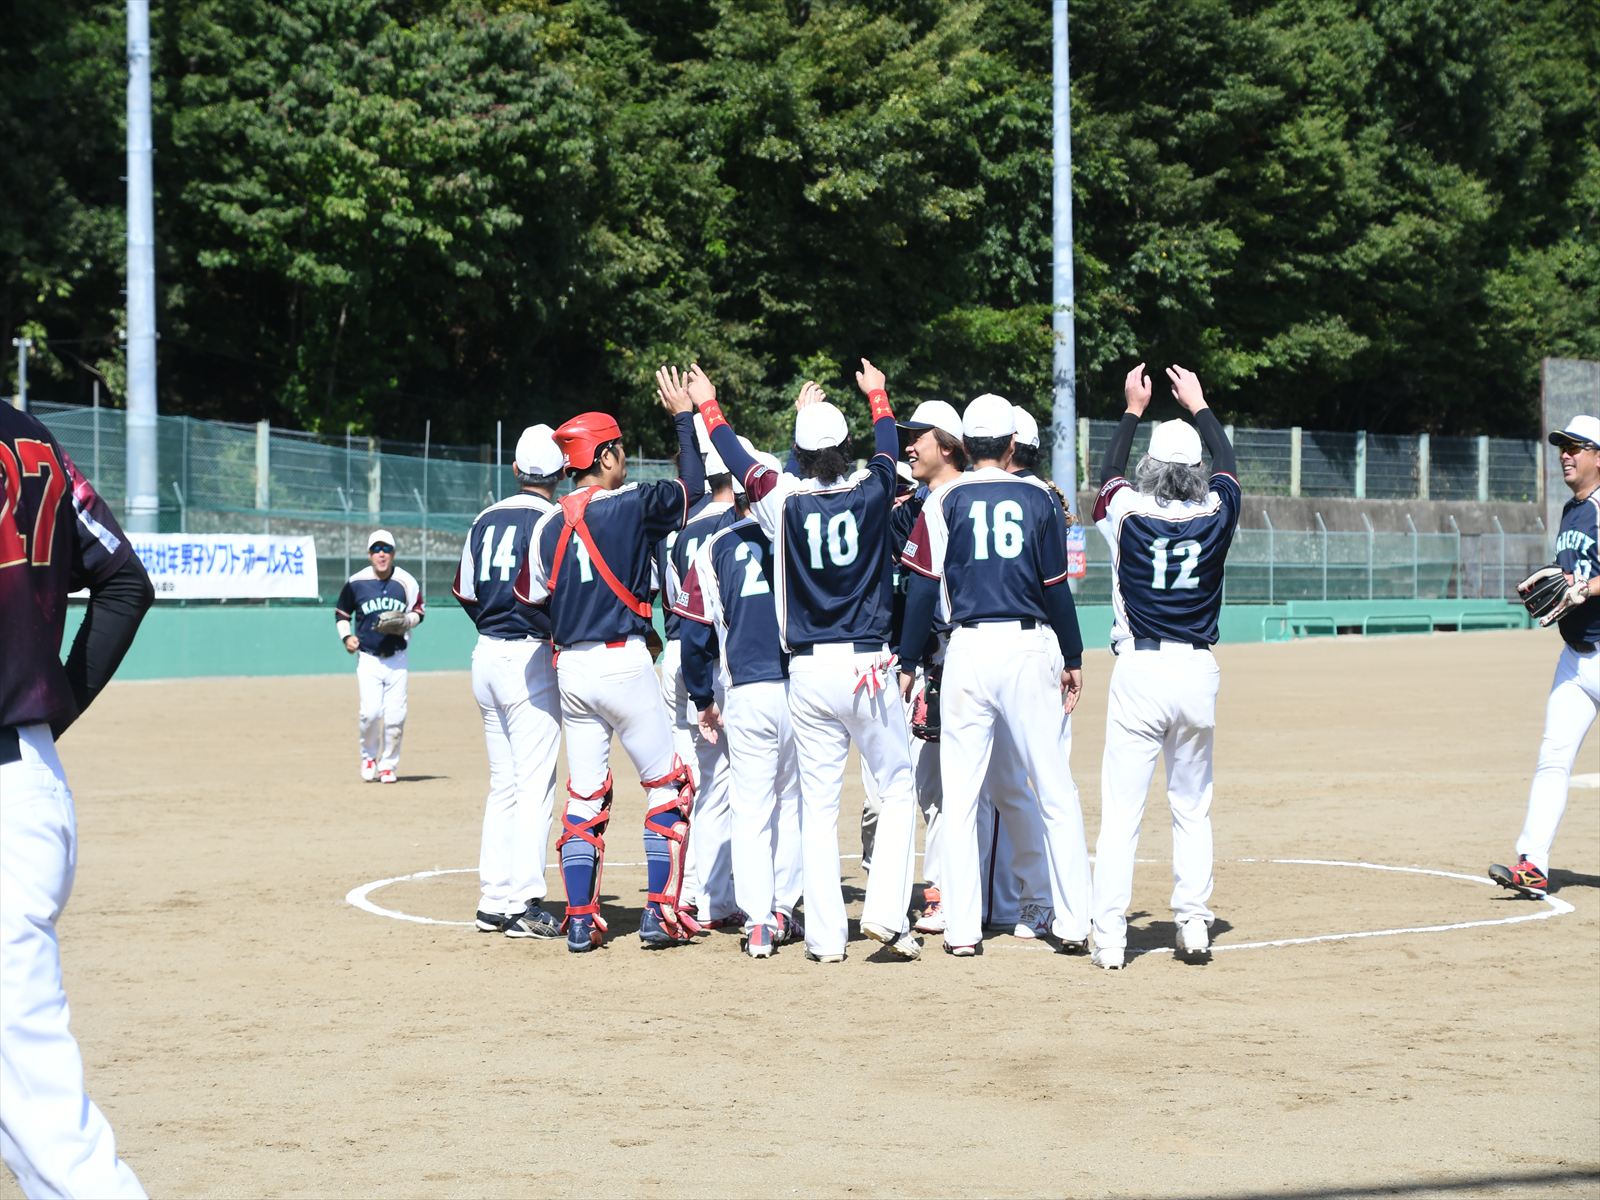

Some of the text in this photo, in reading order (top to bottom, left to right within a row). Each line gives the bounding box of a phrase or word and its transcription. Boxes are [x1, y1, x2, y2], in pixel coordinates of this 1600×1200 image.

[0, 438, 66, 568] 27
[969, 499, 1025, 560] 16
[479, 525, 517, 582] 14
[803, 509, 860, 570] 10
[1148, 537, 1203, 591] 12
[361, 596, 407, 616] KAICITY
